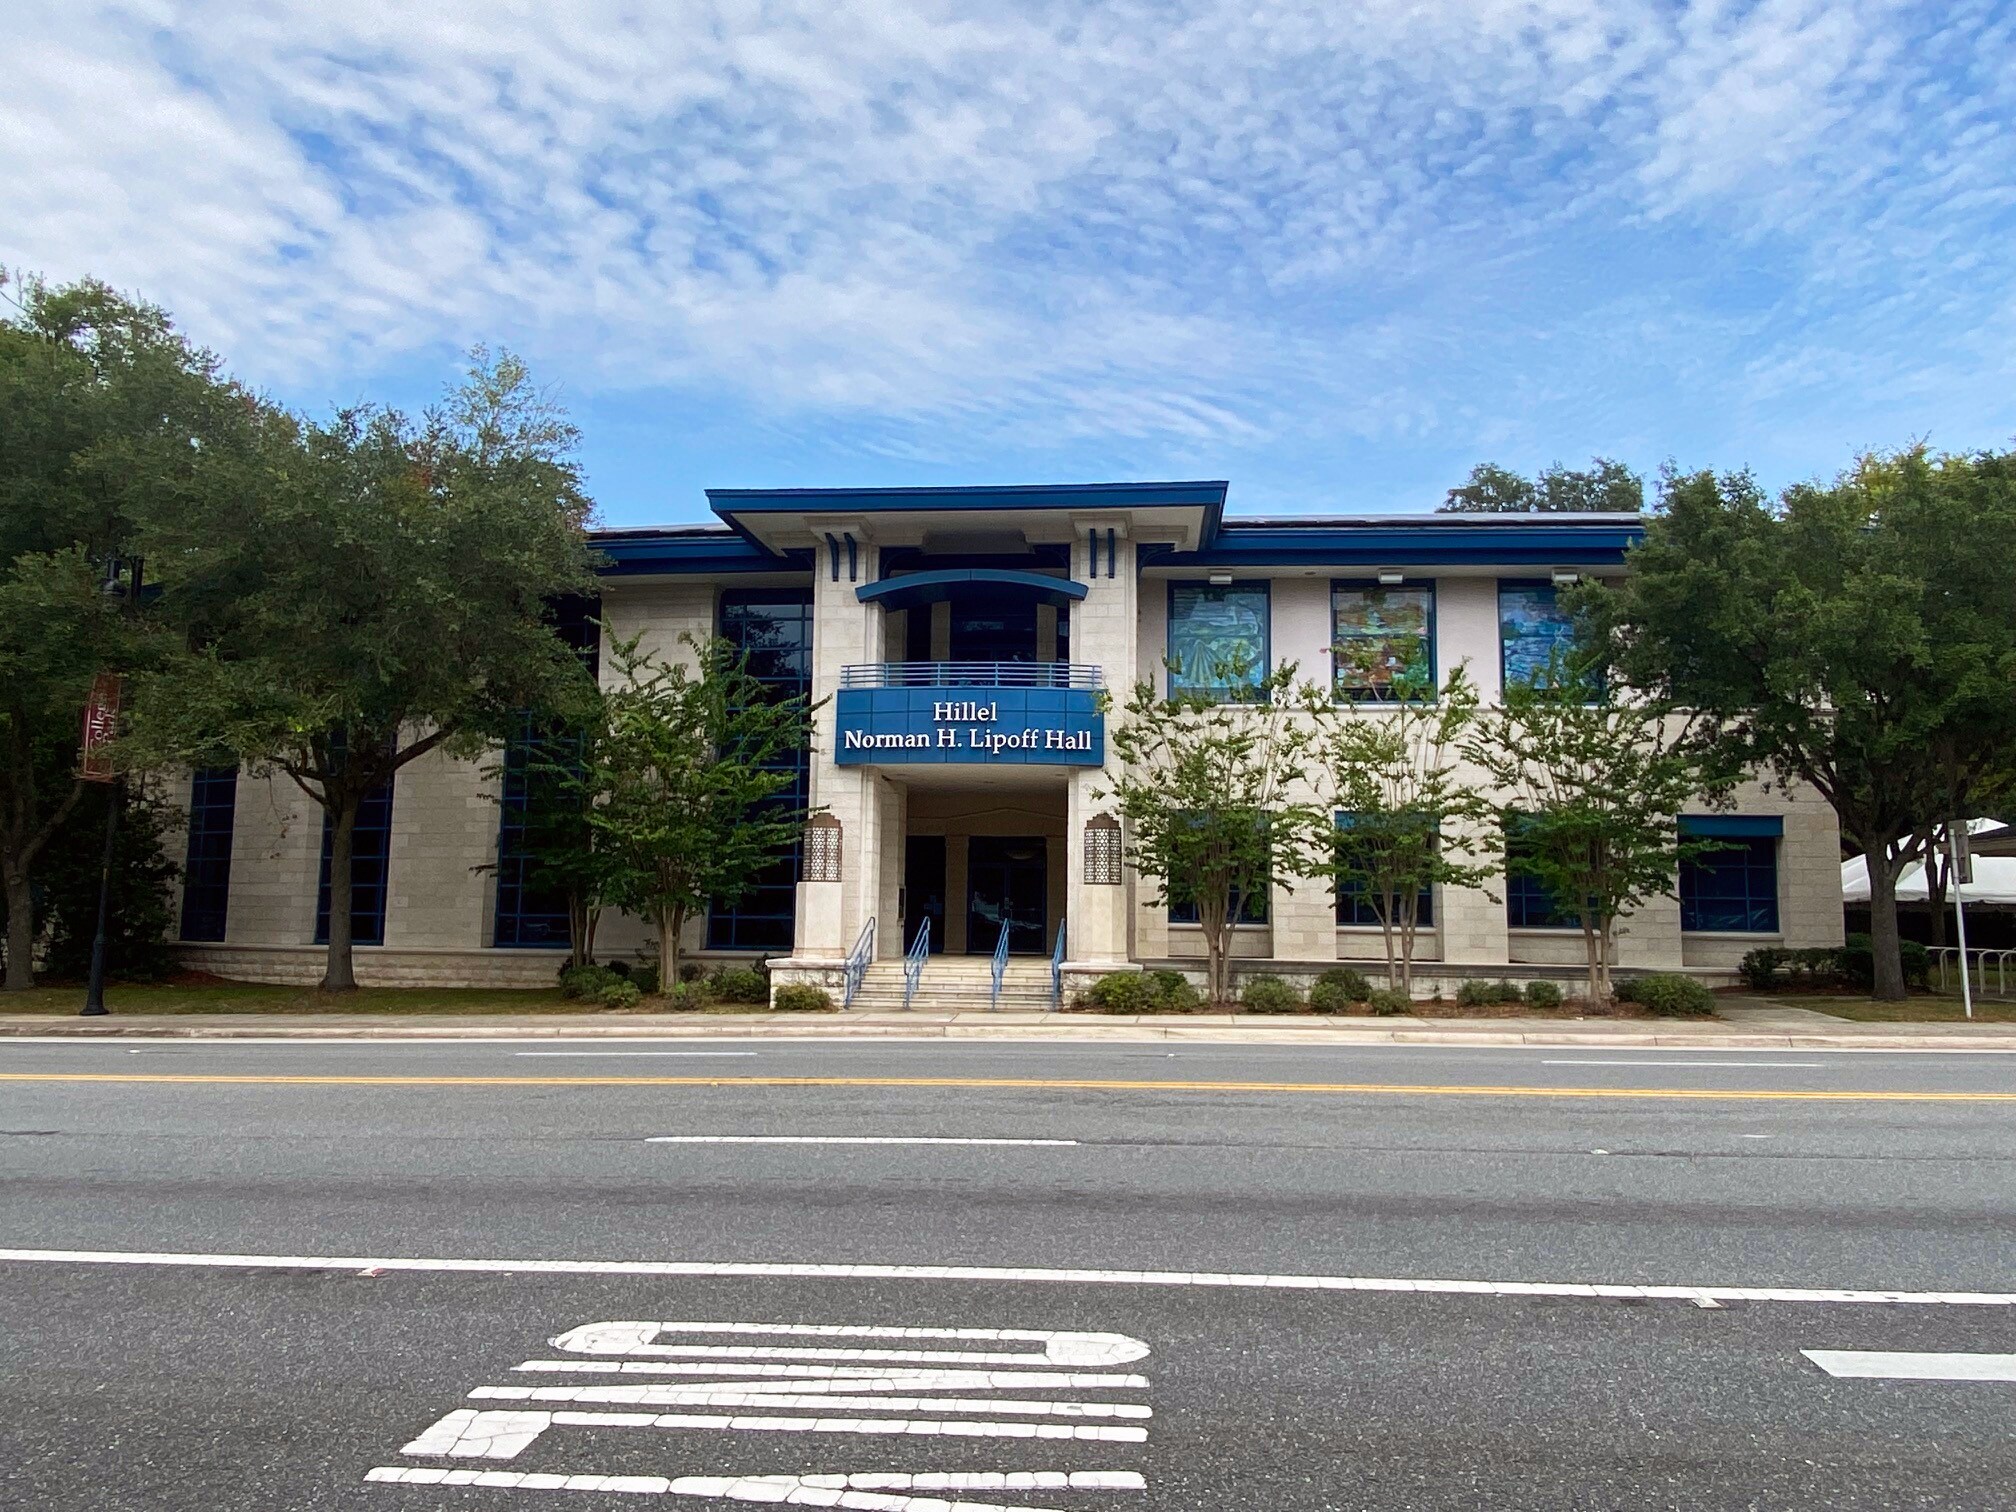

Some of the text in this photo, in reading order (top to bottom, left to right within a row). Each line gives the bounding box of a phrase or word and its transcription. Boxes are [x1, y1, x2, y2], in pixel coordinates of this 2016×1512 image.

[90, 693, 107, 749] Colleg
[933, 701, 998, 721] Hillel
[844, 728, 1092, 754] Norman H. Lipoff Hall
[363, 1320, 1152, 1512] ONLY
